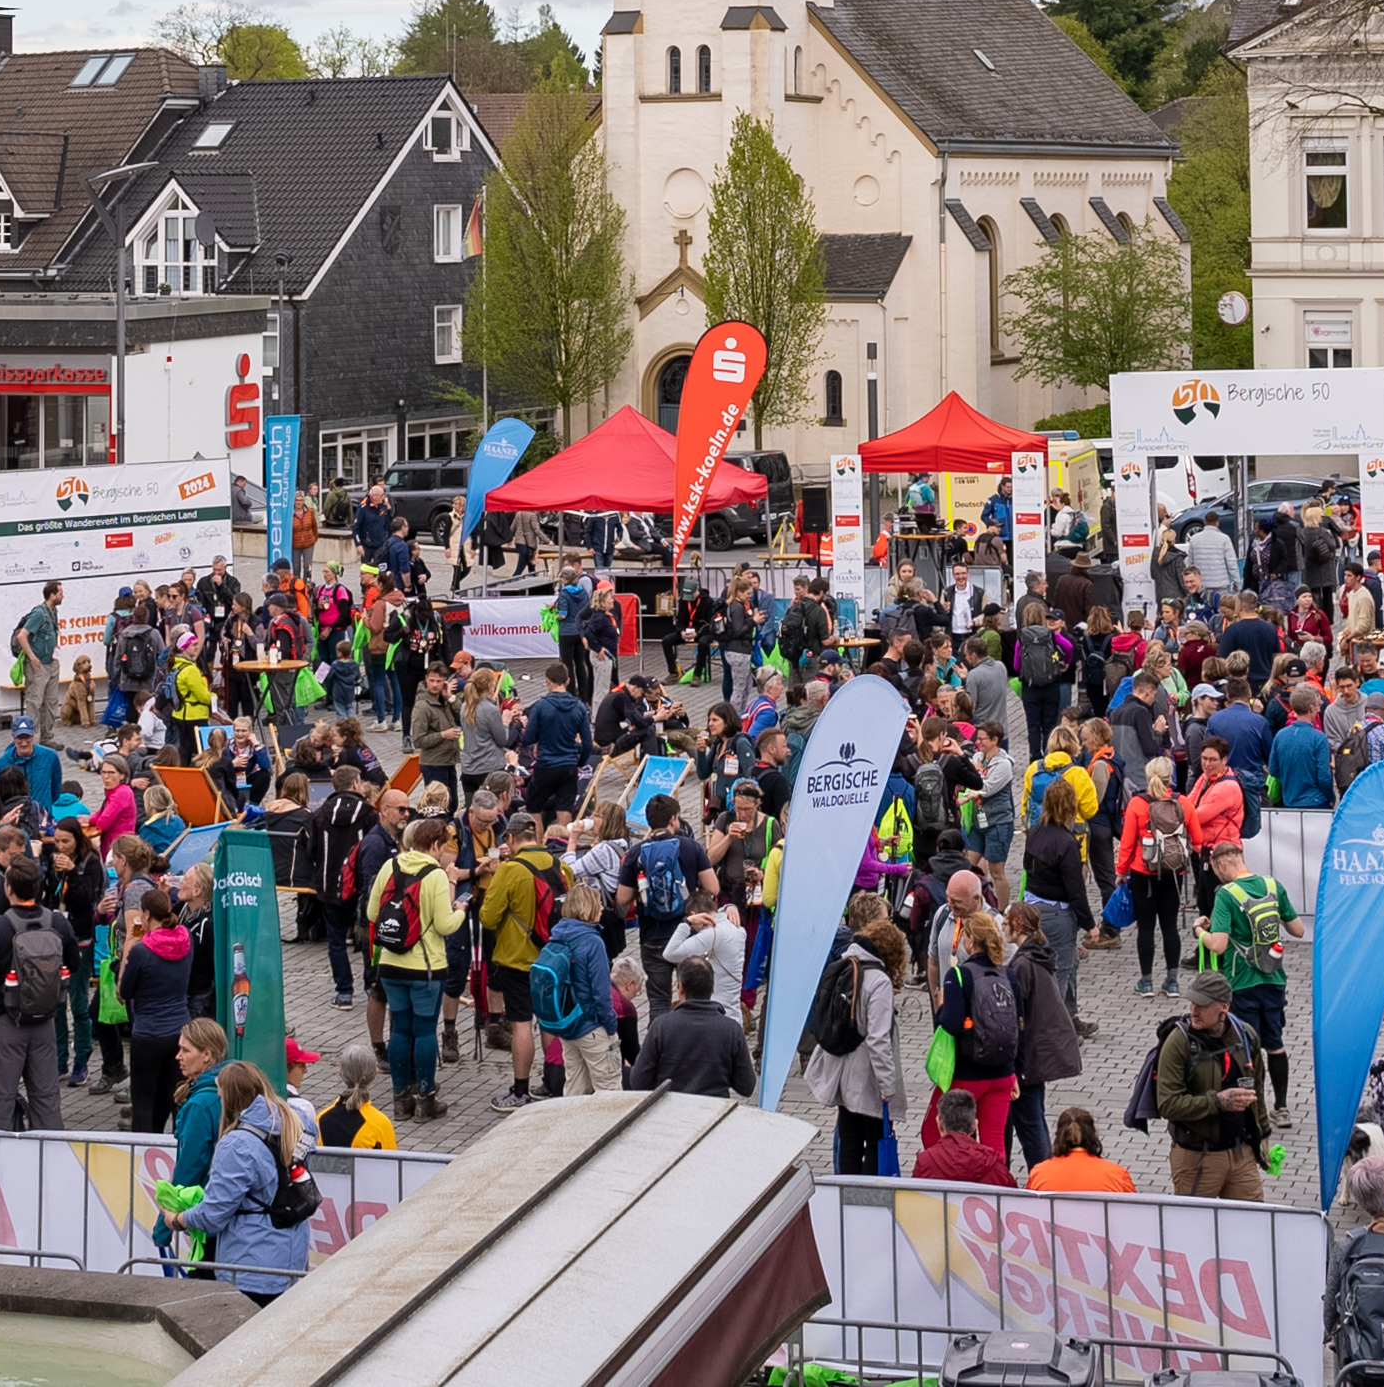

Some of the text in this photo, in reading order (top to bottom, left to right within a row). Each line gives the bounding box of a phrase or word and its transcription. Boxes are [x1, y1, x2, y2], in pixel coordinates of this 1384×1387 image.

[1227, 382, 1304, 407] Bergische
[1312, 383, 1330, 401] 50
[1137, 443, 1190, 452] wipperfürth
[92, 482, 143, 504] Bergische
[147, 482, 159, 496] 50
[183, 476, 211, 497] 2024
[268, 424, 284, 561] perfürth
[17, 510, 198, 533] Das größte Wanderevent im Bergischen Land
[807, 769, 879, 794] BERGISCHE
[812, 791, 870, 809] WALDQUELLE
[227, 871, 262, 888] Kölsch
